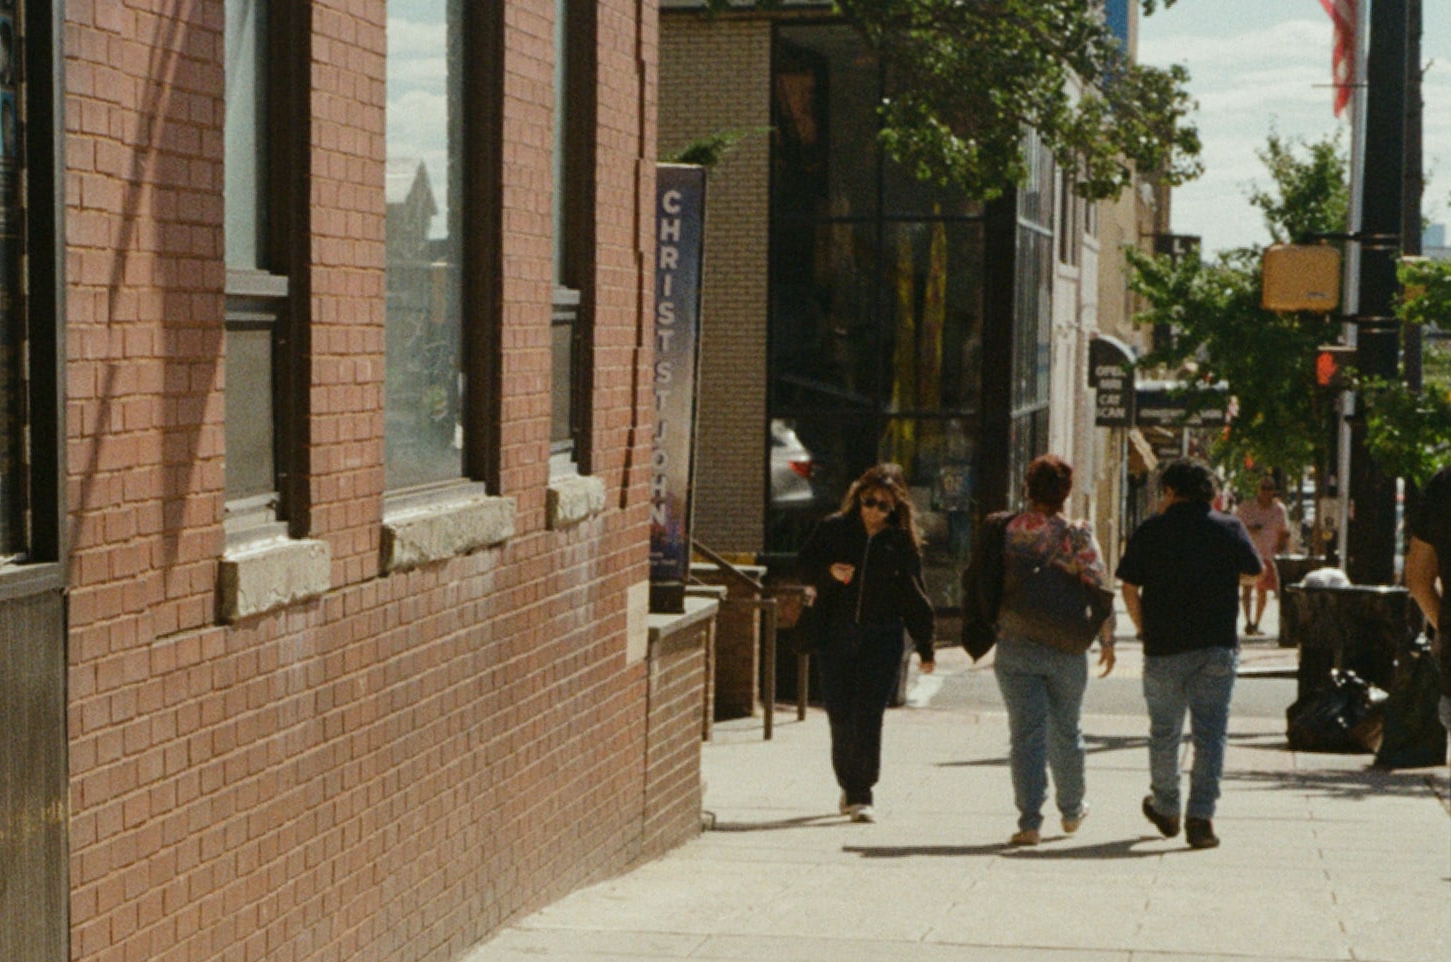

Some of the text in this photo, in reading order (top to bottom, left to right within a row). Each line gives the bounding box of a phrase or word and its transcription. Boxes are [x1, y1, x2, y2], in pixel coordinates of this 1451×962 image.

[657, 190, 682, 352] CHRIST
[653, 361, 674, 411] ST
[649, 421, 670, 526] JOHN
